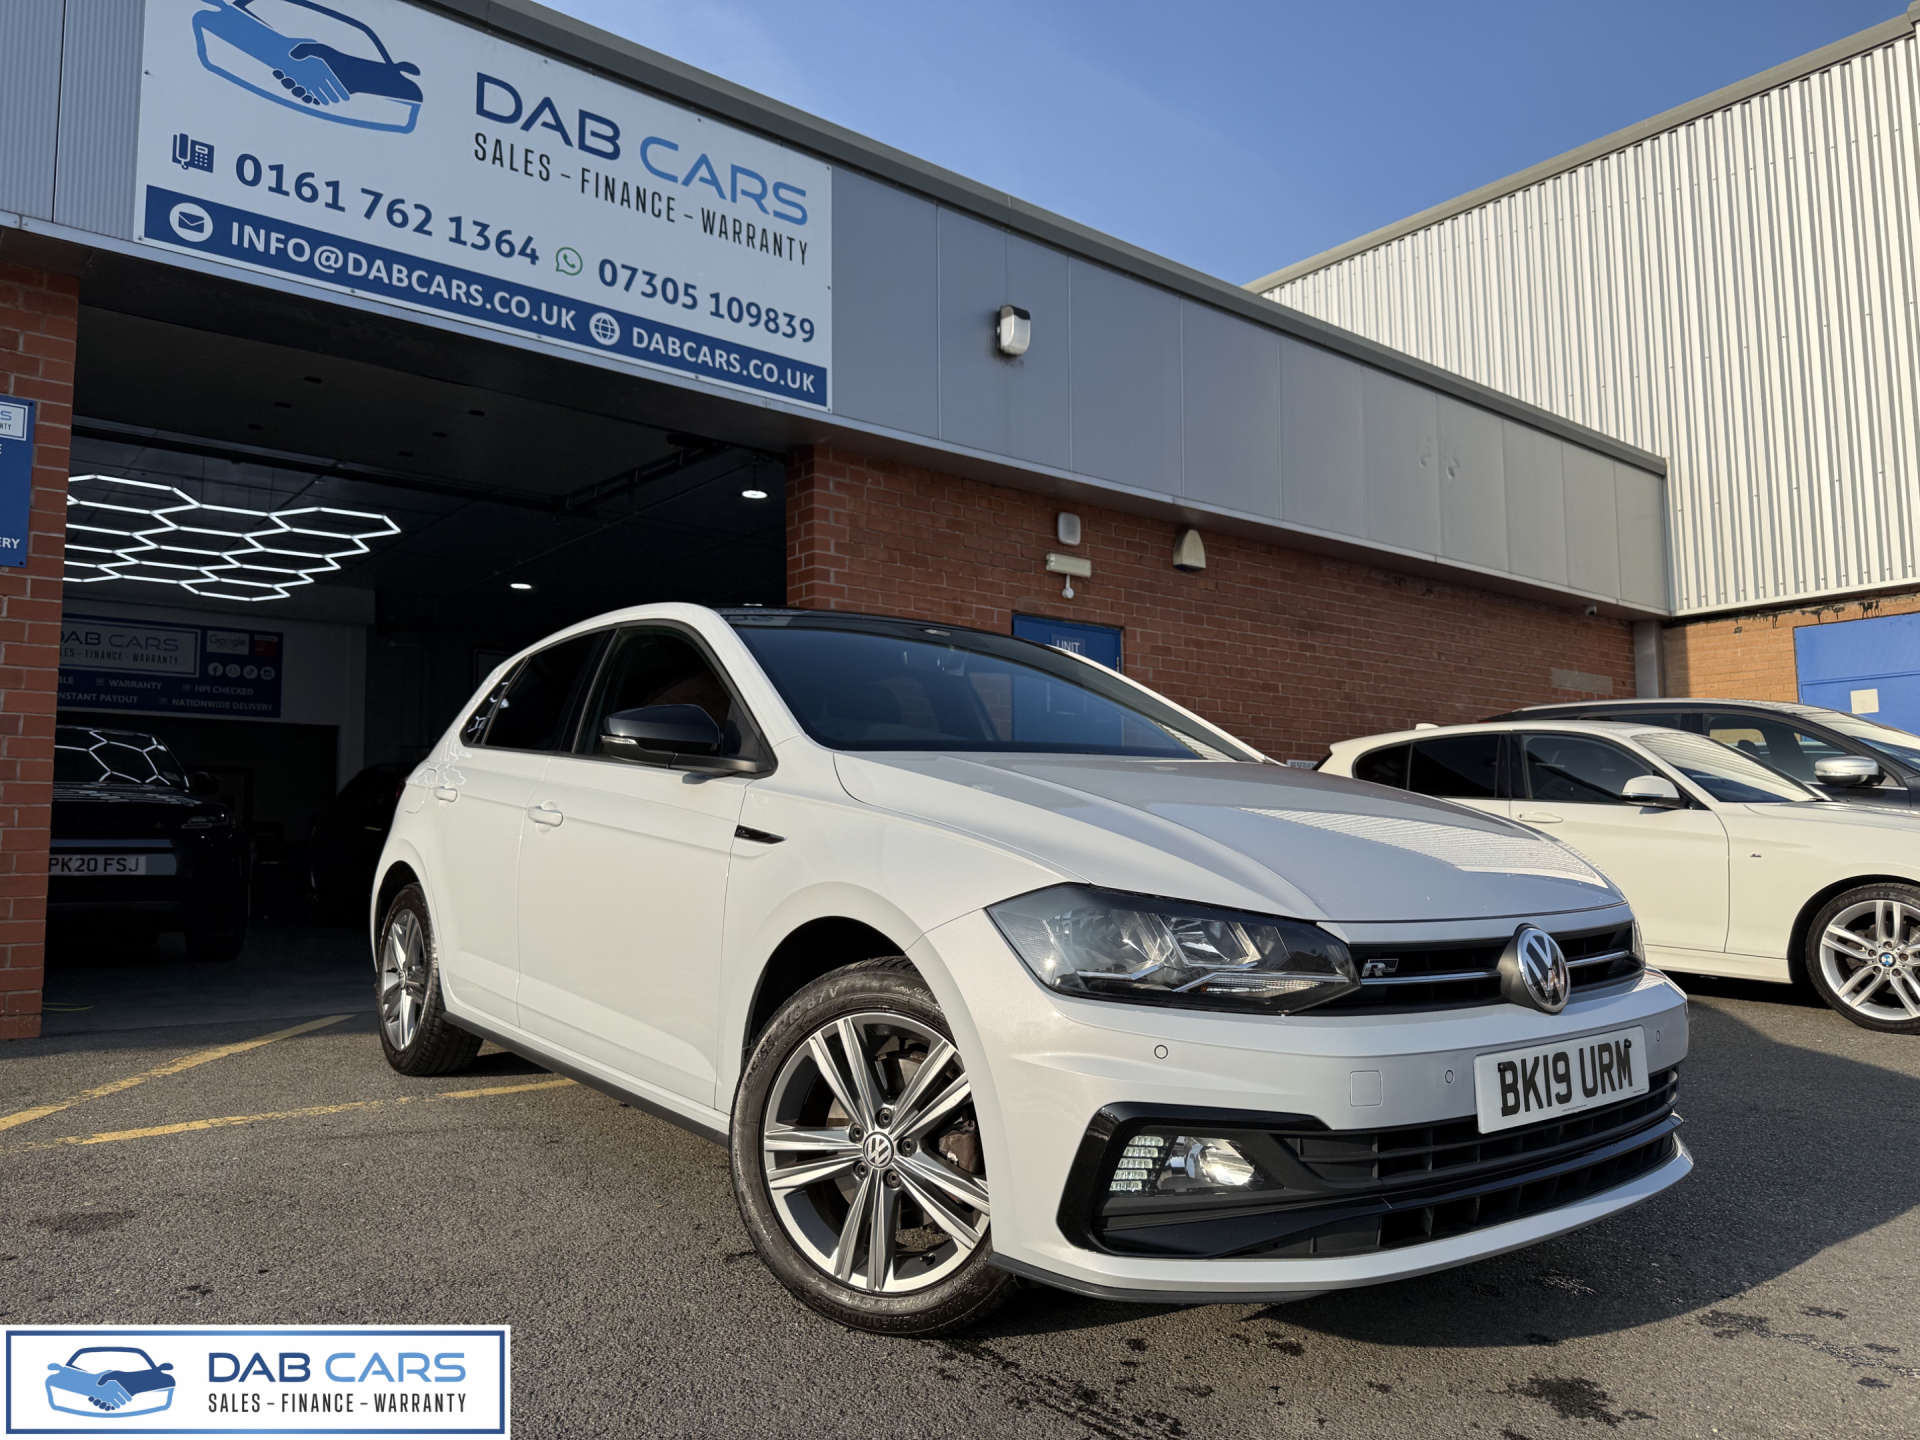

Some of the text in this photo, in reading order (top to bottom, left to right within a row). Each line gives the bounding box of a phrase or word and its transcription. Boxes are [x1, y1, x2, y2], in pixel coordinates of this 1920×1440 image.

[476, 71, 808, 226] DAB CARS
[235, 153, 540, 266] 0161 762 1364
[474, 132, 551, 182] SALES
[580, 168, 676, 224] FINANCE
[701, 207, 808, 265] WARRANTY
[231, 220, 577, 332] INFO@DABCARS.CO.UK
[598, 258, 815, 343] 07305 109839
[632, 327, 816, 393] DABCARS.CO.UK
[61, 630, 179, 652] AB CARS
[59, 691, 272, 711] NSTANT PAYOUT NATIONWIDE DELIVERY
[109, 678, 162, 690] WARRANTY
[48, 857, 140, 873] PK20 FSJ
[1497, 1038, 1633, 1117] BK19 URM
